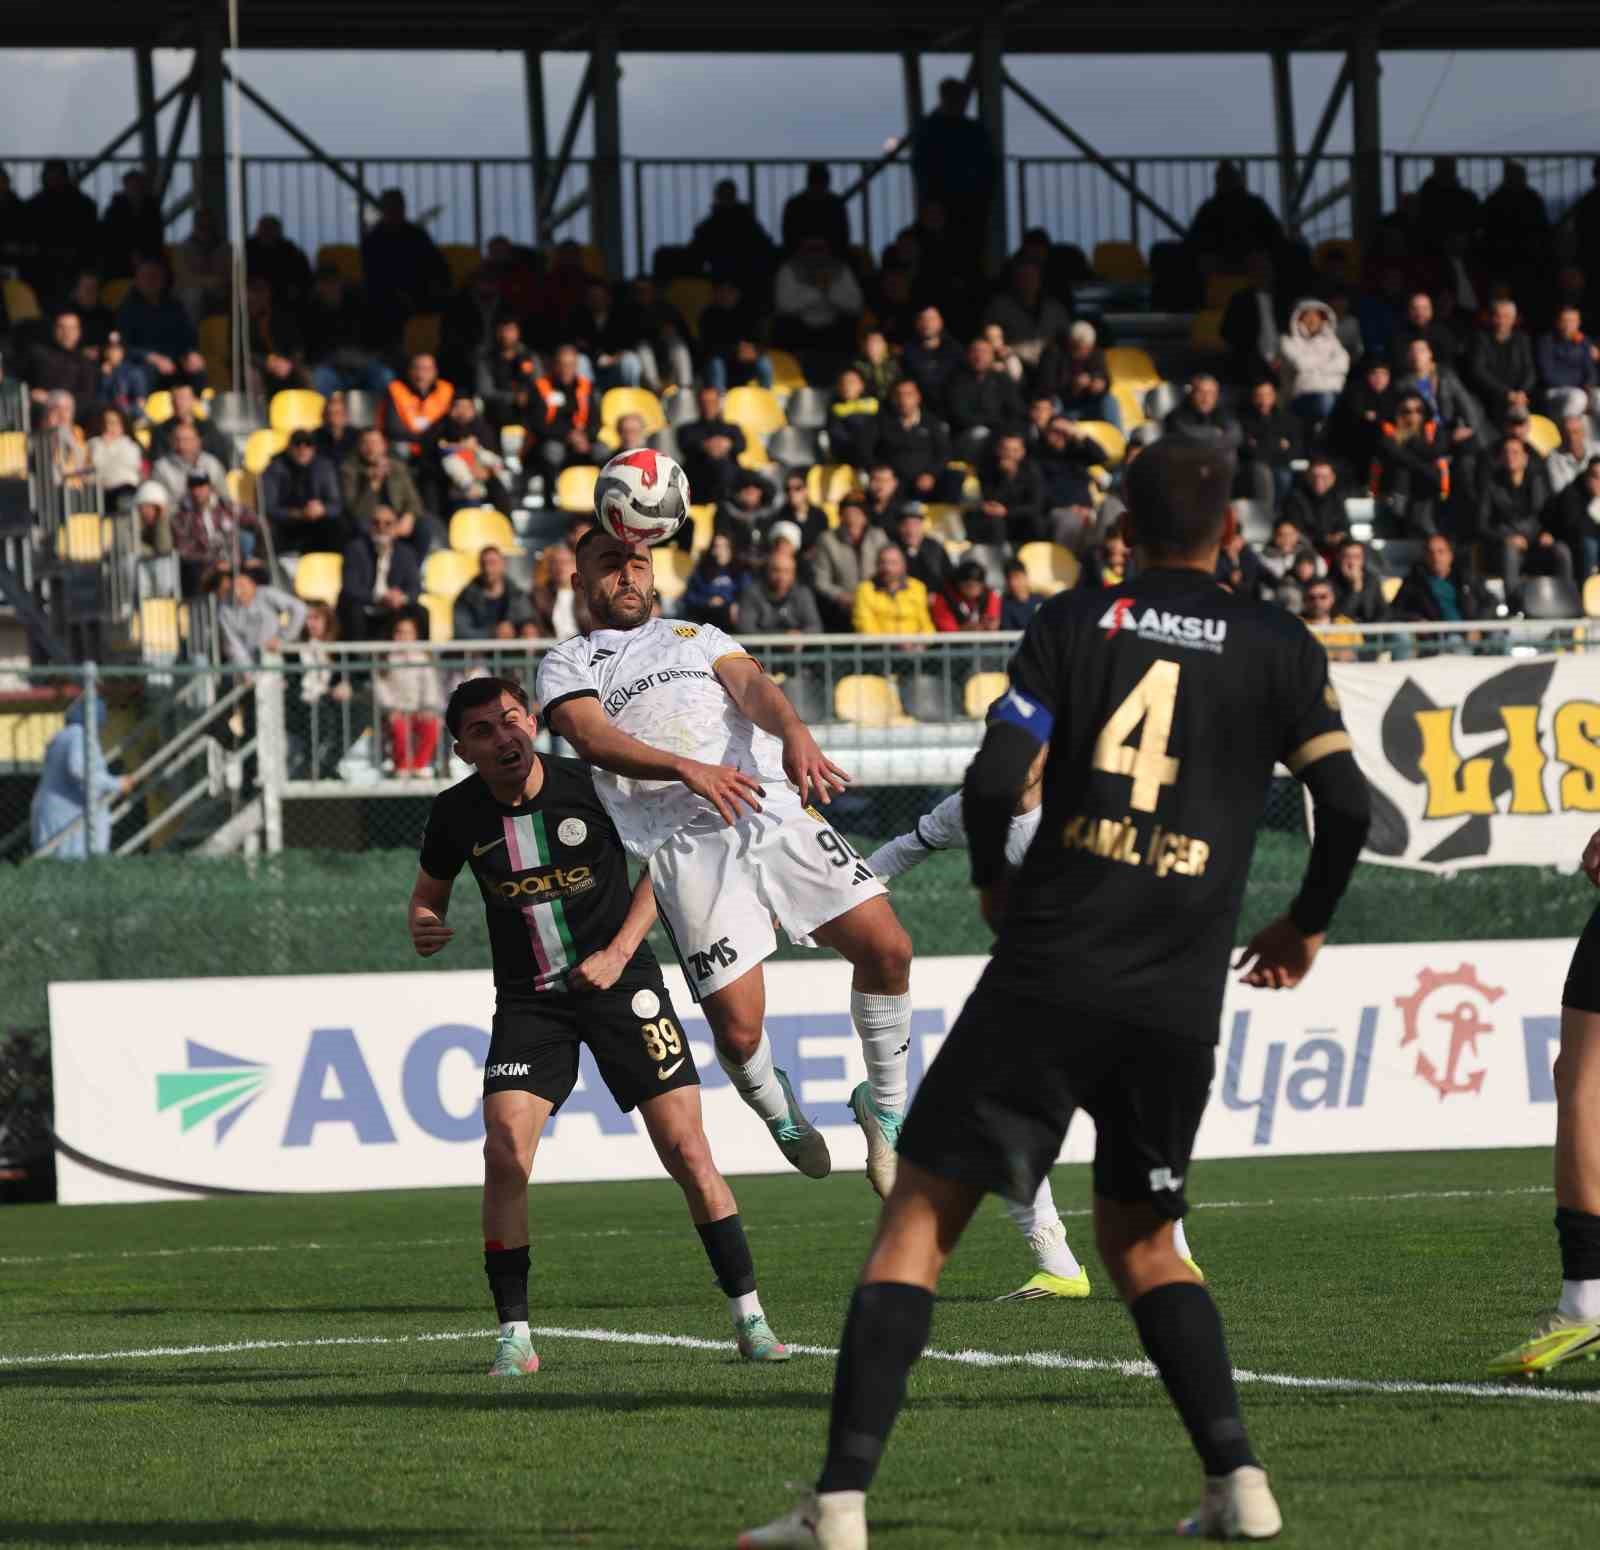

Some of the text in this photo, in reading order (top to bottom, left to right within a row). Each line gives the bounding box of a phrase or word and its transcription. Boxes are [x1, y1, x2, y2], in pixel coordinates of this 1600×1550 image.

[1138, 607, 1227, 641] AKSU
[1093, 658, 1181, 813] 4
[688, 936, 738, 981] ZMS
[643, 1018, 682, 1061] 89
